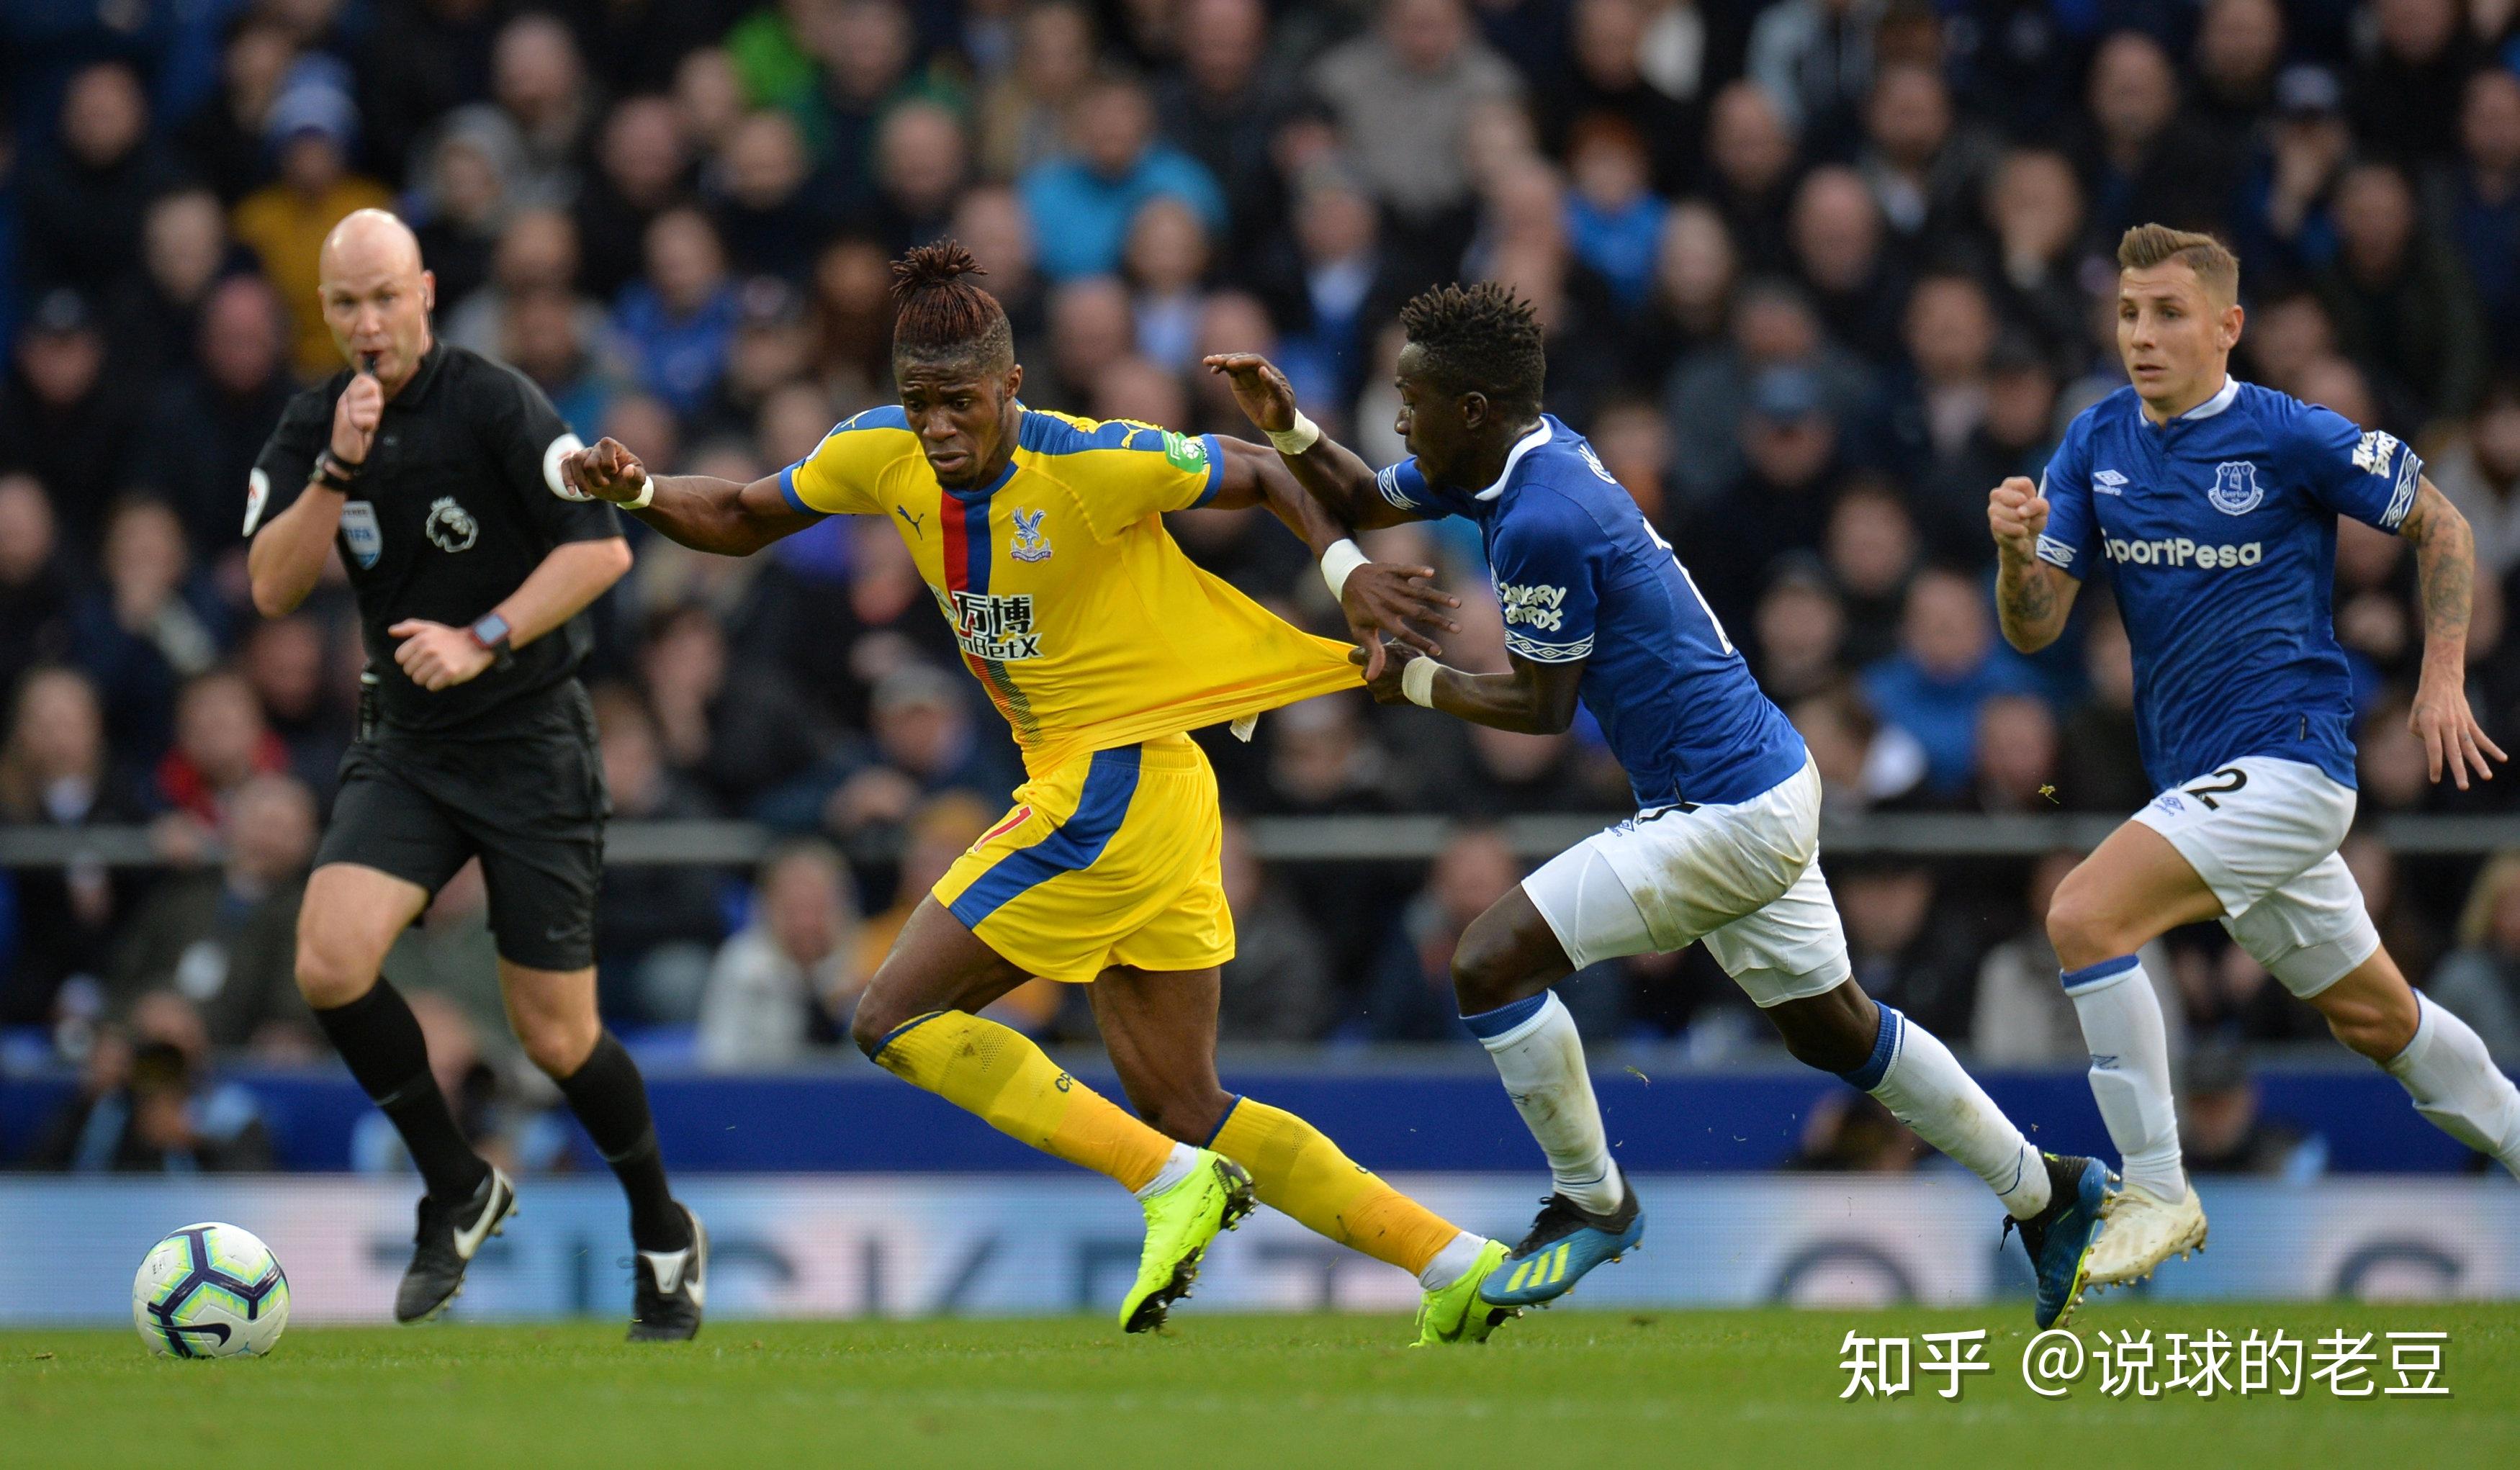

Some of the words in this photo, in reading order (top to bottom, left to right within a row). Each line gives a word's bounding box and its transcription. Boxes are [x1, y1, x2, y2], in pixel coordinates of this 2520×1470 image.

[2221, 489, 2250, 498] Everton
[1500, 582, 1567, 610] ANGRY
[1505, 607, 1563, 632] BIRDS
[959, 633, 1043, 661] nBetX
